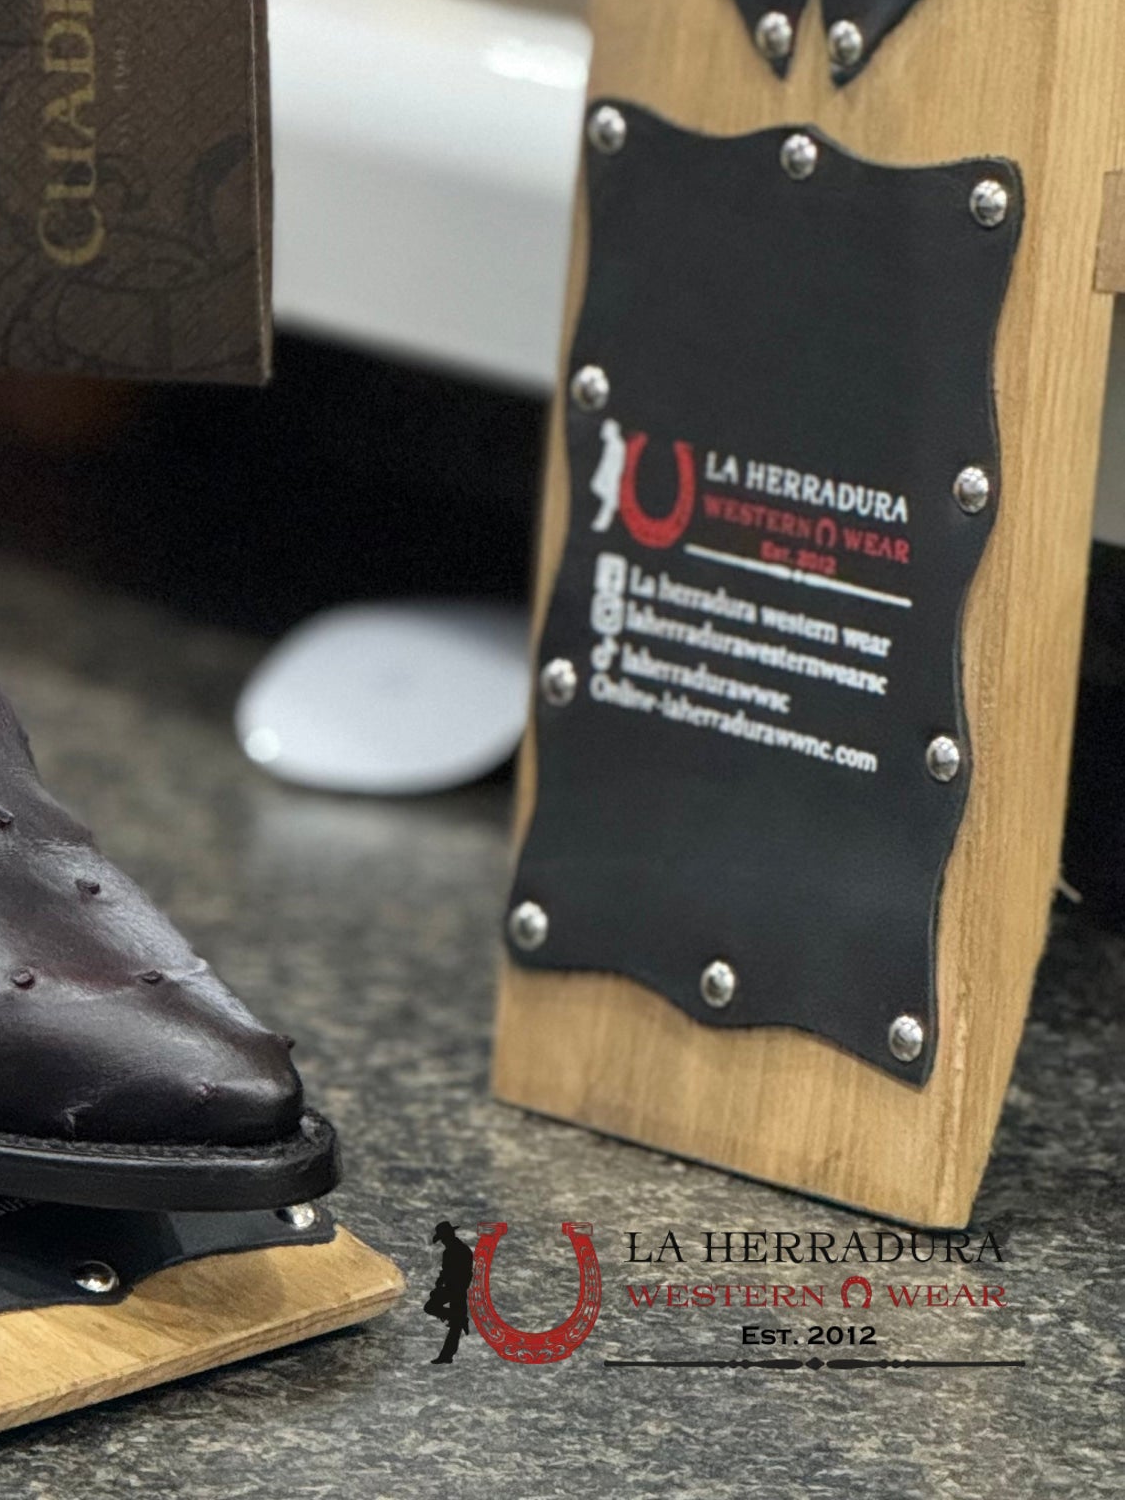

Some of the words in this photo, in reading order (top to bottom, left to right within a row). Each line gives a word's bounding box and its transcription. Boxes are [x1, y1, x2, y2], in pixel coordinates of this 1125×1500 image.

[704, 450, 738, 484] LA
[745, 459, 909, 524] HERRADURA
[702, 493, 812, 539] WESTERN
[842, 527, 911, 564] WEAR
[630, 565, 656, 597] La
[658, 572, 758, 625] herradura
[761, 605, 838, 647] western
[842, 626, 893, 658] wear
